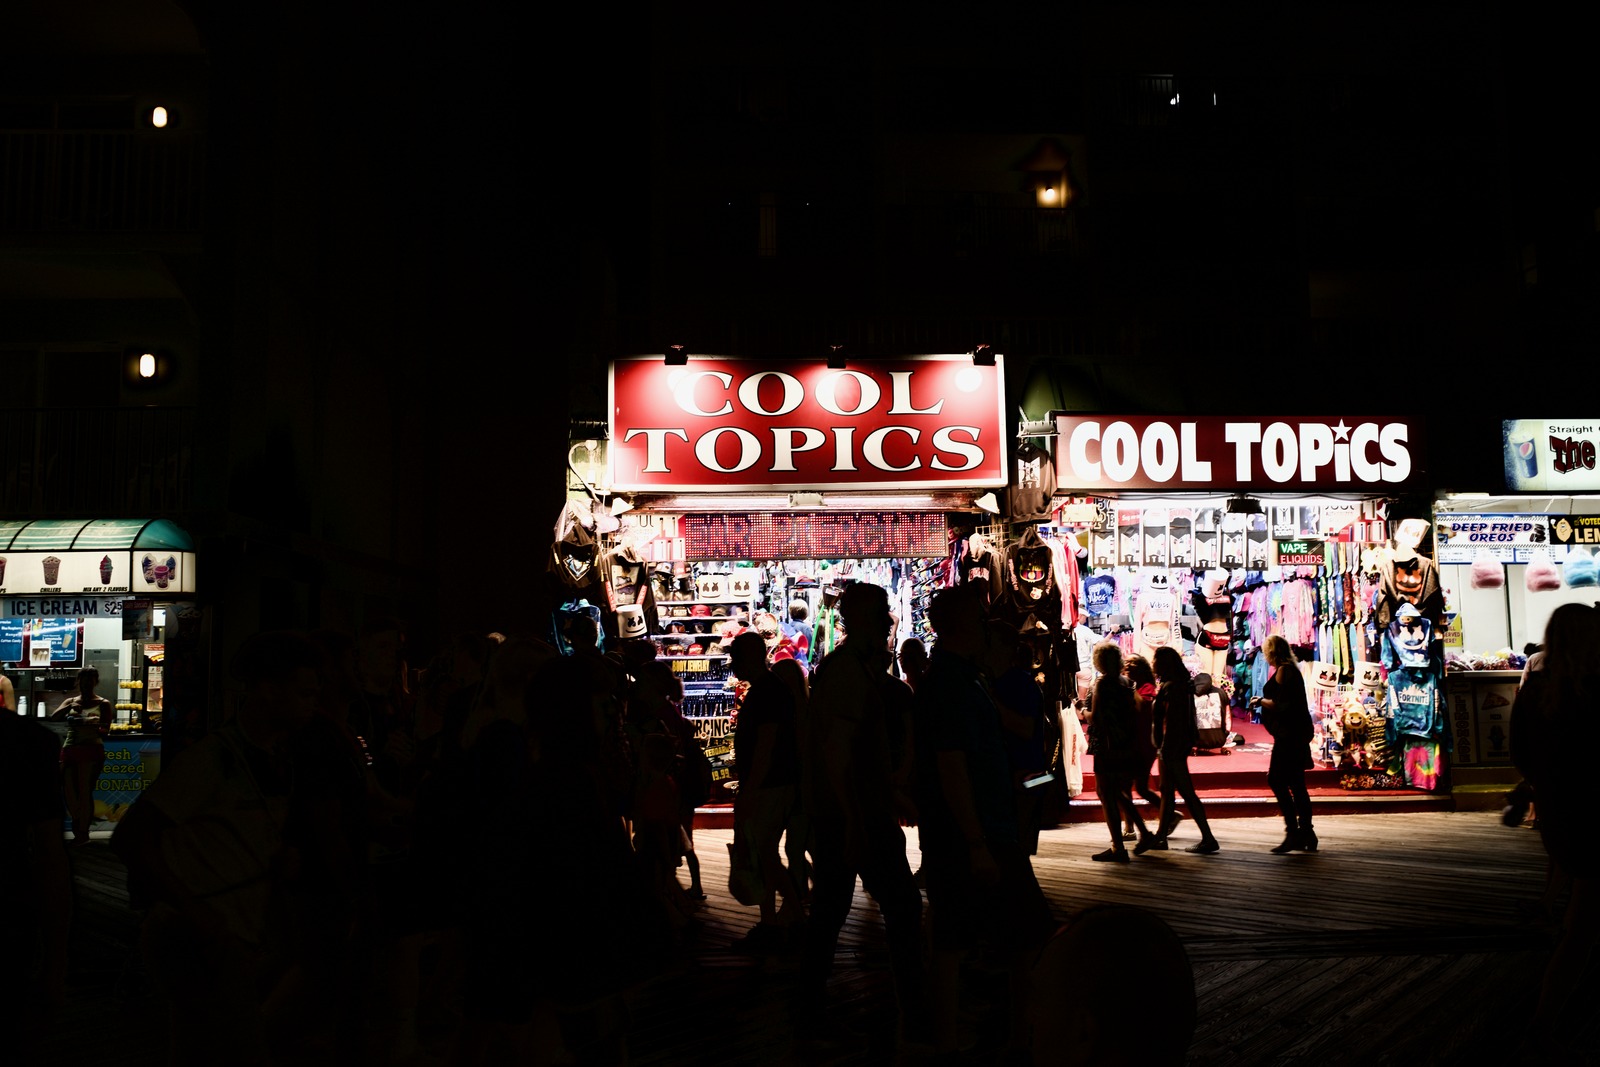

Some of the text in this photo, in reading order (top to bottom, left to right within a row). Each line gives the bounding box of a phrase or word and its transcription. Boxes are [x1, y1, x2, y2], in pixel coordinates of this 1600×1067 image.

[673, 370, 944, 417] COOL
[1549, 425, 1593, 434] Straight
[623, 425, 985, 474] TOPICS
[1070, 421, 1212, 483] COOL
[1549, 435, 1596, 474] The
[1452, 522, 1533, 532] DEEP FRIED
[1469, 533, 1516, 542] OREOS
[1280, 543, 1308, 554] VAPE
[1280, 554, 1323, 565] ELIQUIDS
[11, 600, 36, 616] ICE
[40, 600, 98, 616] CREAM
[1399, 692, 1428, 704] FORTNITE
[711, 767, 730, 781] 19.99
